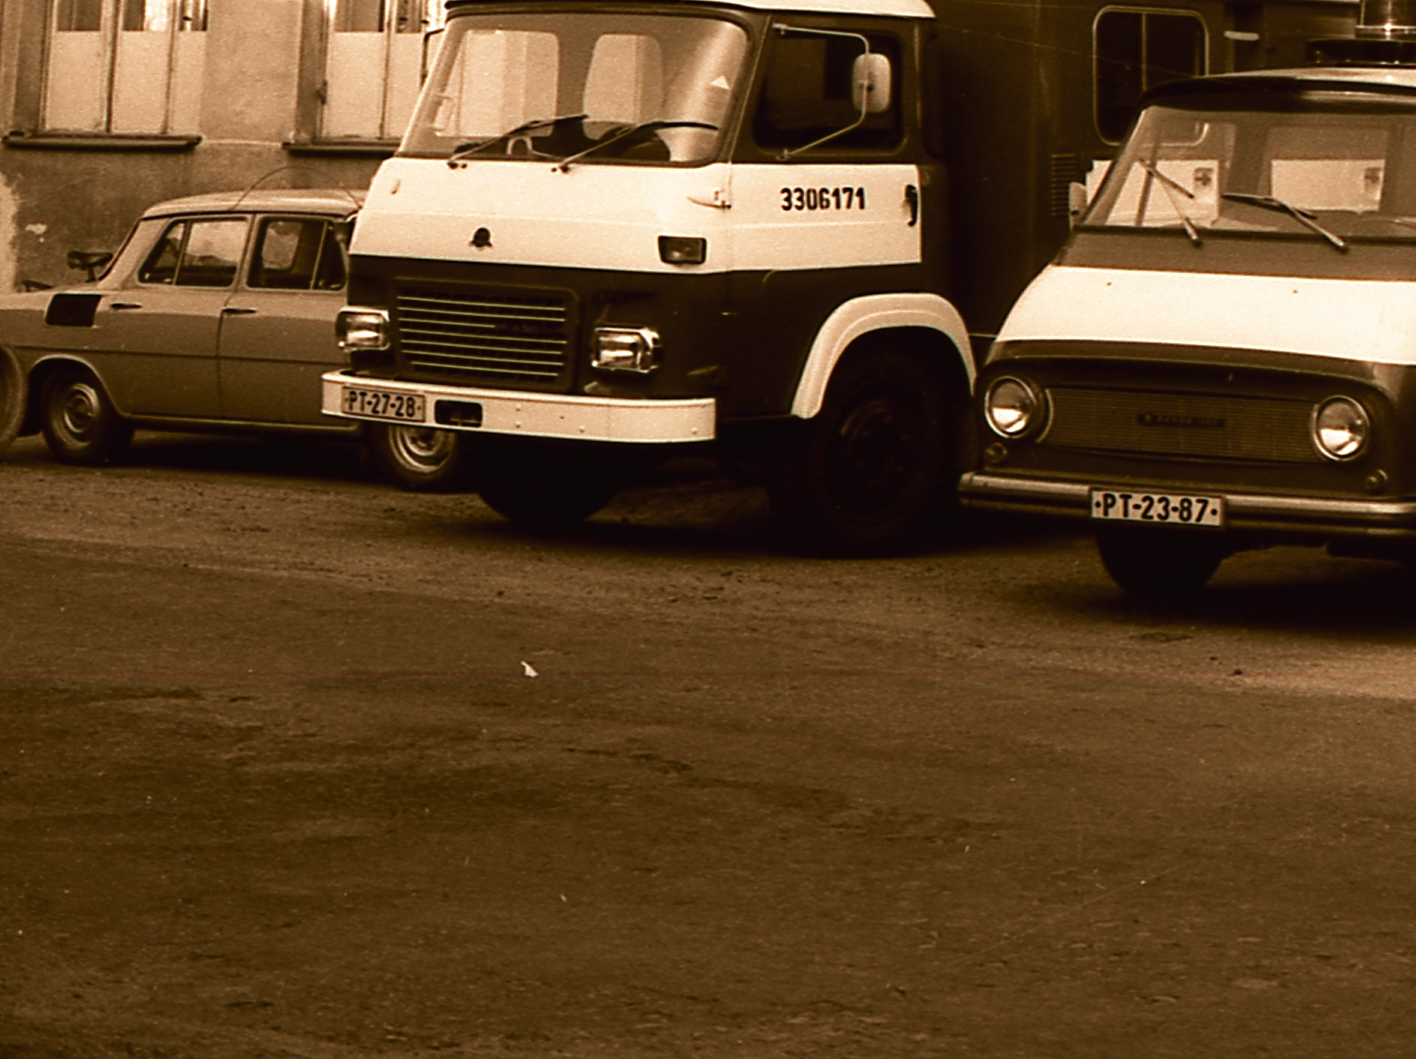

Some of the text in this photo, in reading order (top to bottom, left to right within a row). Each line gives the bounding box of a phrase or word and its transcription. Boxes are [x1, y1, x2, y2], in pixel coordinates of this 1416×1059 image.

[779, 186, 867, 212] 3306171
[348, 390, 417, 418] PT-27-28
[1101, 492, 1210, 525] PT-23-87
